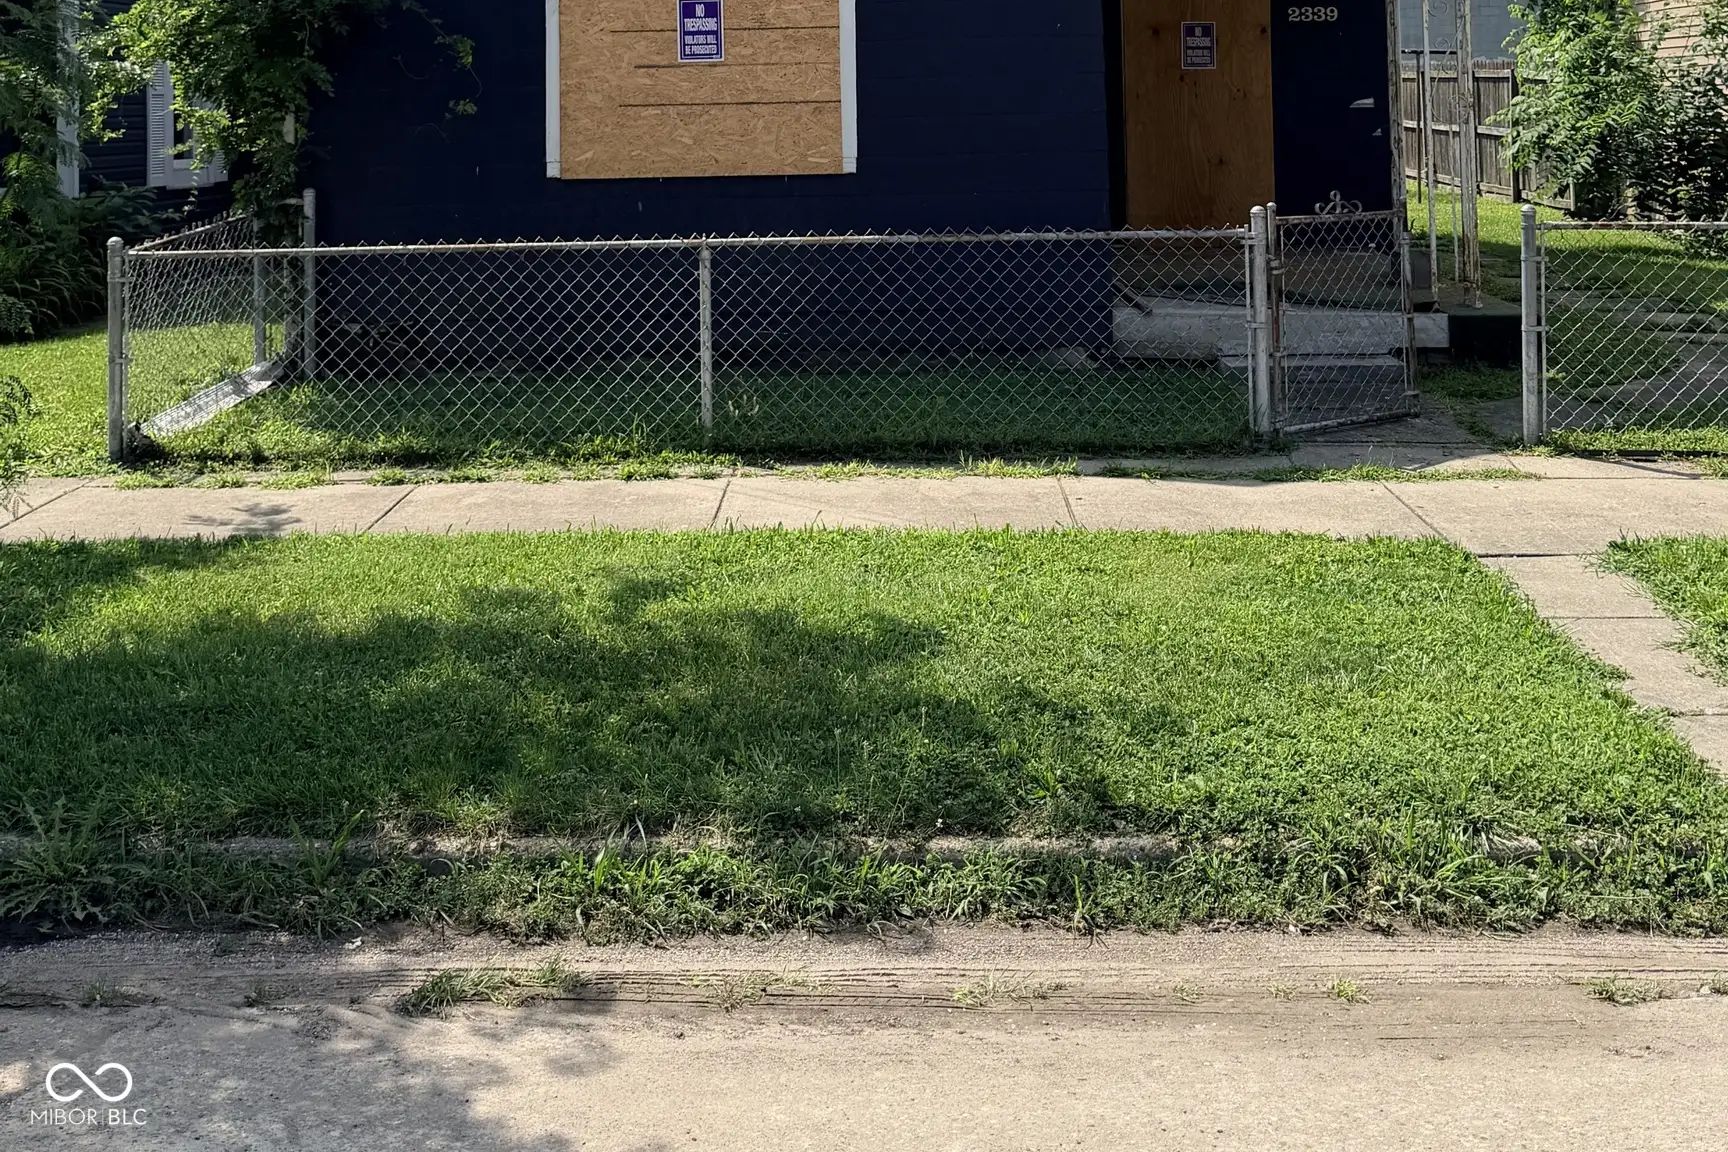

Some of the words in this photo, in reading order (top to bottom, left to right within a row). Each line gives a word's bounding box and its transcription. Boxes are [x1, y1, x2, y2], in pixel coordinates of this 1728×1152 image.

[695, 3, 705, 18] NO
[1288, 6, 1338, 22] 2339
[684, 17, 717, 31] TRESPASSING
